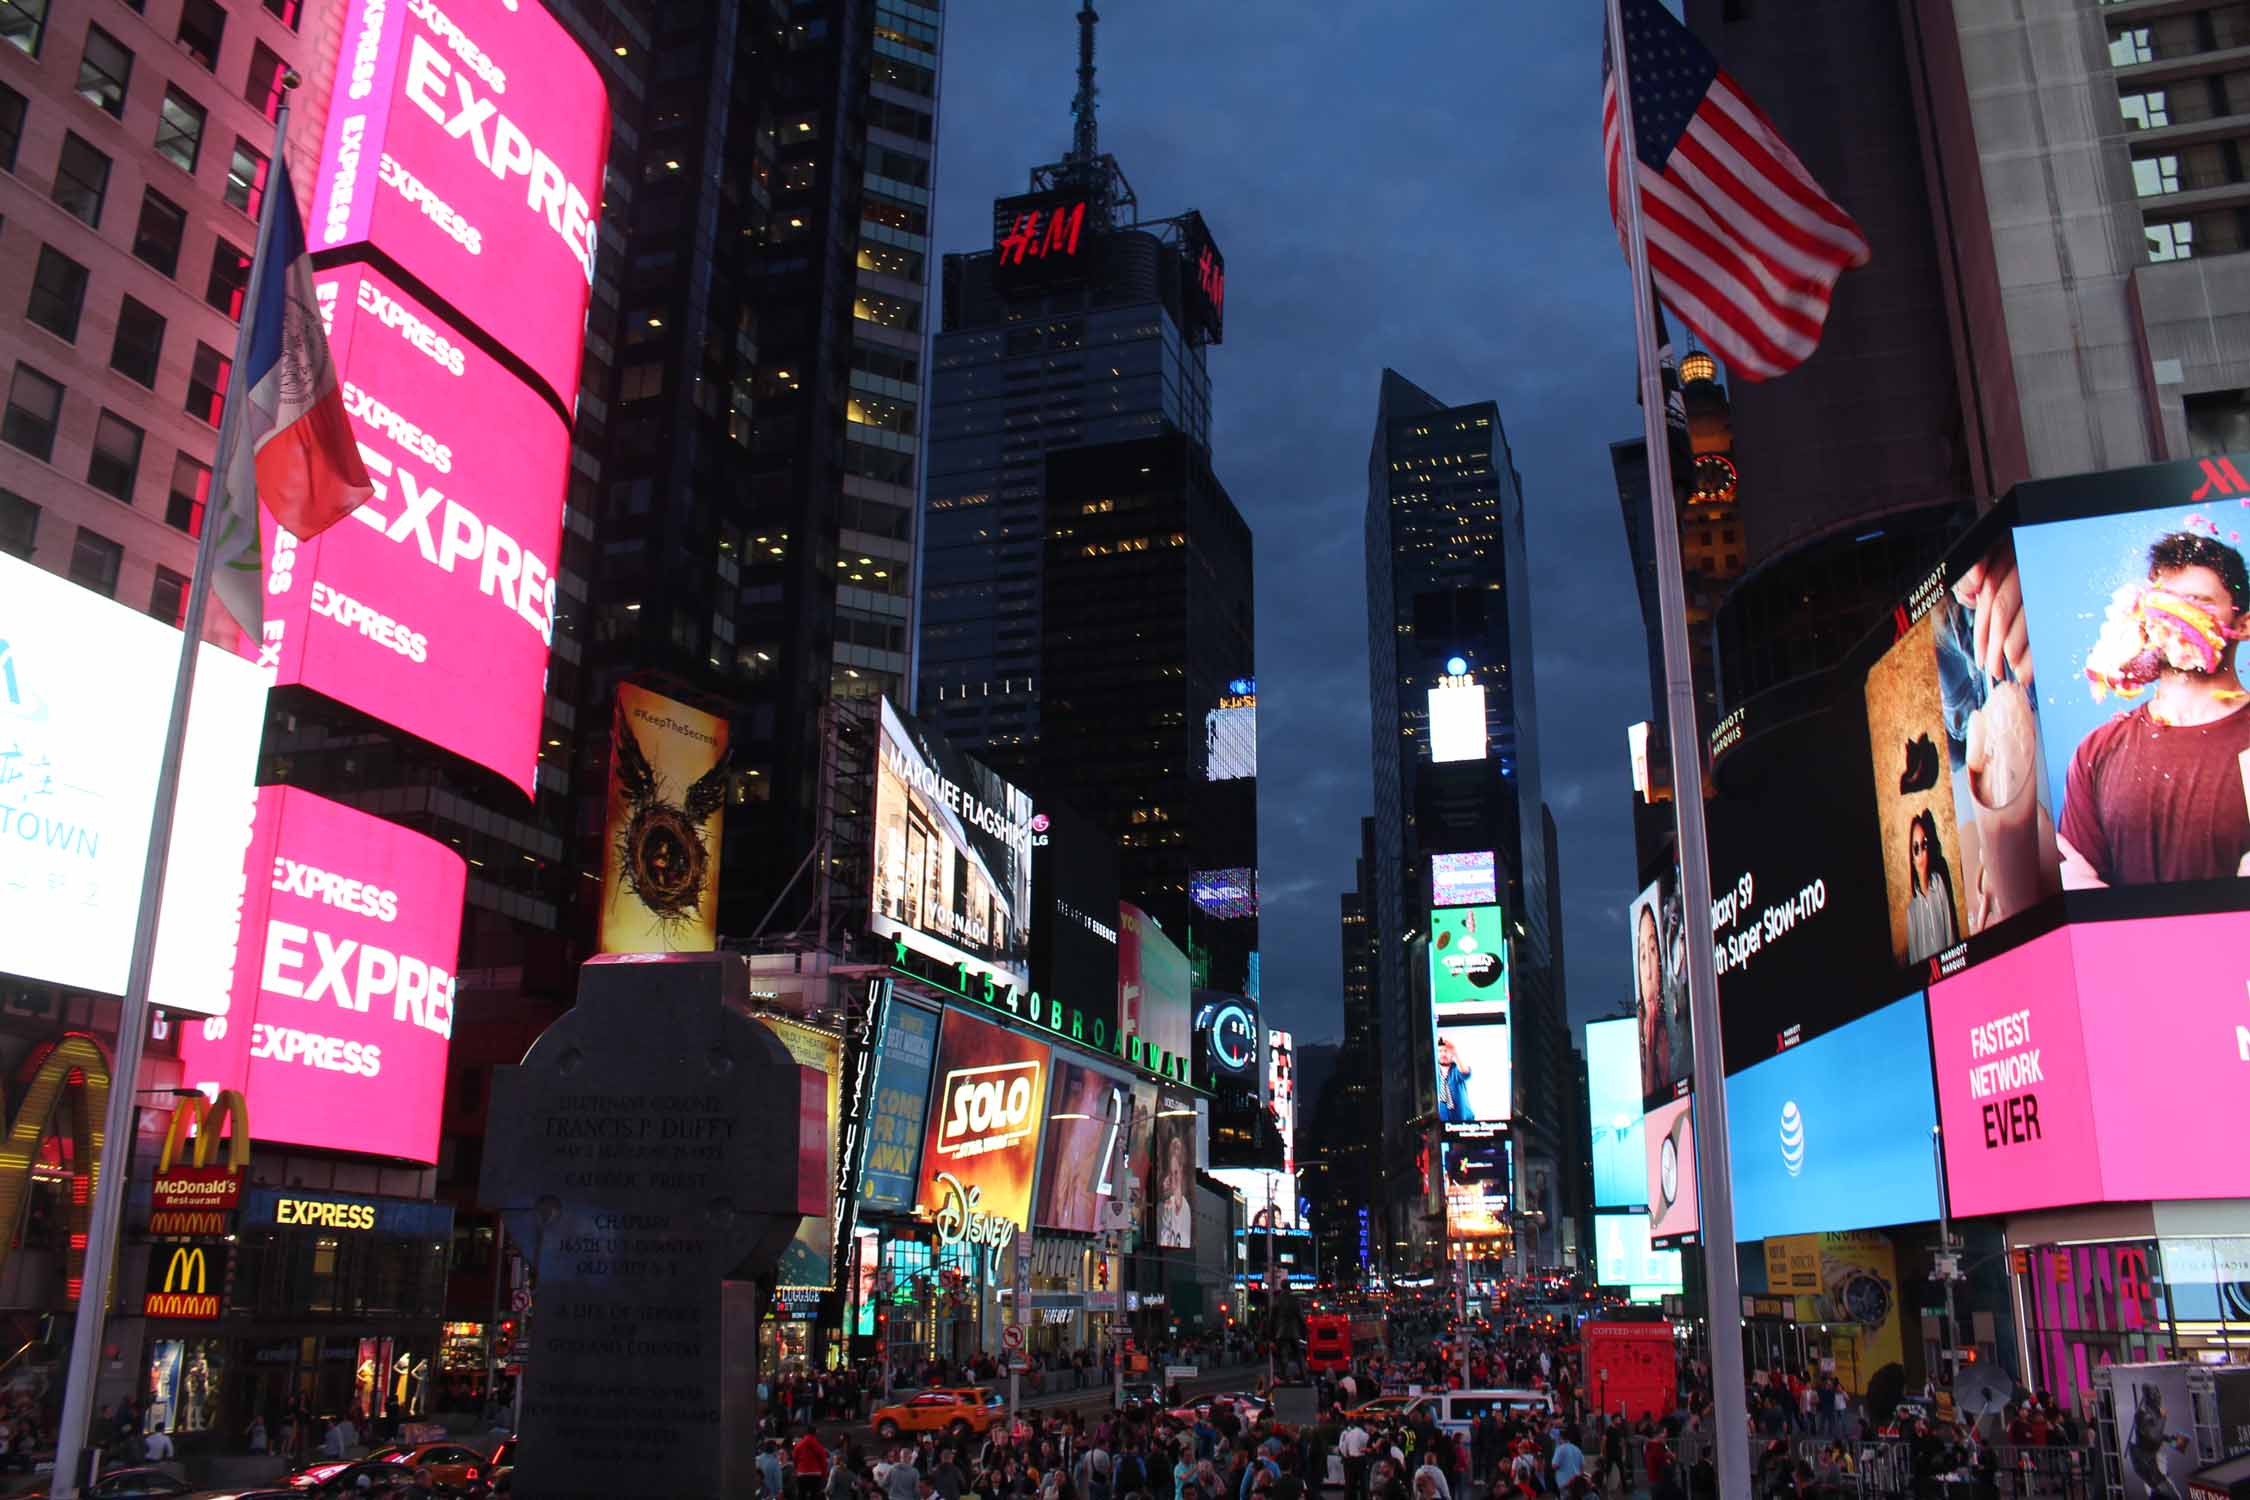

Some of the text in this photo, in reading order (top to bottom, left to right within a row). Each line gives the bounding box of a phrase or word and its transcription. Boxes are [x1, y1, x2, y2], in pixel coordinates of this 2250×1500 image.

[324, 114, 366, 244] EXPRESS
[377, 152, 483, 255] EXPRESS
[1000, 202, 1086, 267] H&M
[357, 279, 465, 377] EXPRESS
[342, 381, 452, 474] EXPRESS
[1908, 562, 1947, 608] MARRIOTT
[1911, 582, 1945, 623] MARQUIS
[310, 580, 428, 663] EXPRESS
[1711, 707, 1746, 743] MARRIOTT
[1713, 725, 1742, 757] MARQUIS
[889, 743, 1026, 854] MARQUEE FLAGSHIPS
[1032, 835, 1049, 846] LG
[272, 857, 397, 922] EXPRESS
[1739, 872, 1753, 910] S9
[1763, 878, 1826, 944] Slow-mo
[250, 1023, 381, 1077] EXPRESS
[958, 962, 1190, 1083] 1540 BROADWAY
[1970, 1009, 2031, 1059] FASTEST
[1969, 1049, 2044, 1100] NETWORK
[946, 1076, 1031, 1138] SOLO
[1982, 1093, 2042, 1149] EVER
[155, 1180, 236, 1195] McDonald's
[166, 1197, 221, 1205] Restaurant
[276, 1199, 376, 1230] EXPRESS
